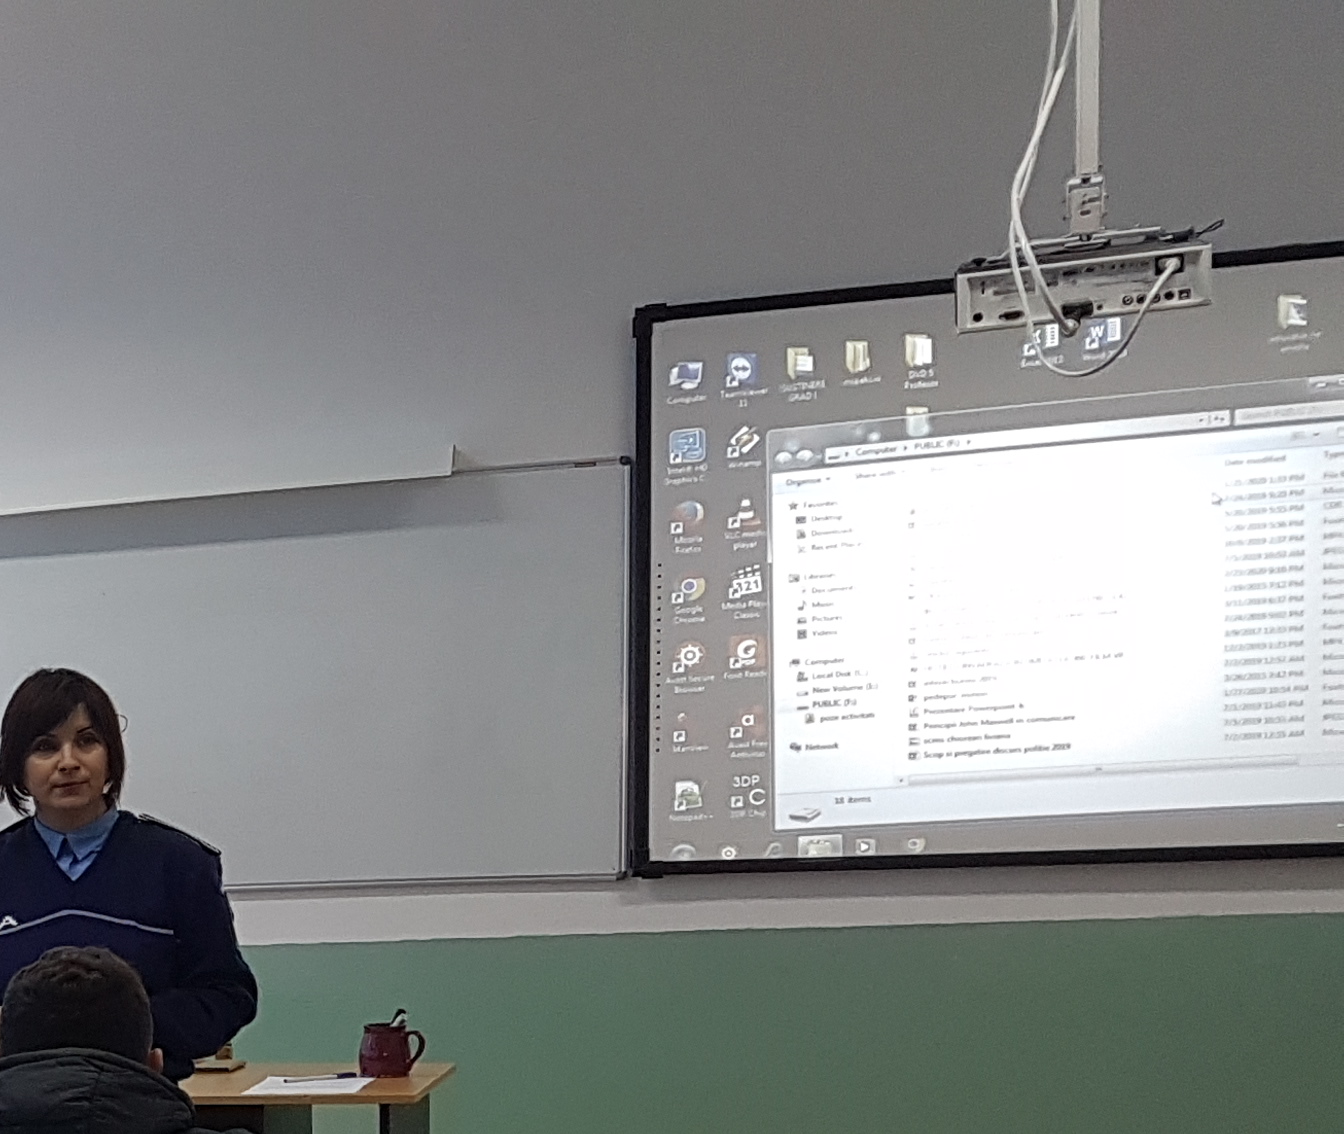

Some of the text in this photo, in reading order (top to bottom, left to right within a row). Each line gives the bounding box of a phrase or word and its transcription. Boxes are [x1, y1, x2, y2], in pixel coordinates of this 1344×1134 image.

[856, 445, 897, 456] Computer
[915, 440, 944, 449] PUBLIC
[1246, 454, 1286, 465] modified
[805, 657, 845, 666] Computer
[805, 742, 839, 751] Network
[732, 775, 760, 788] 3DP
[749, 788, 766, 805] C
[848, 795, 871, 804] items
